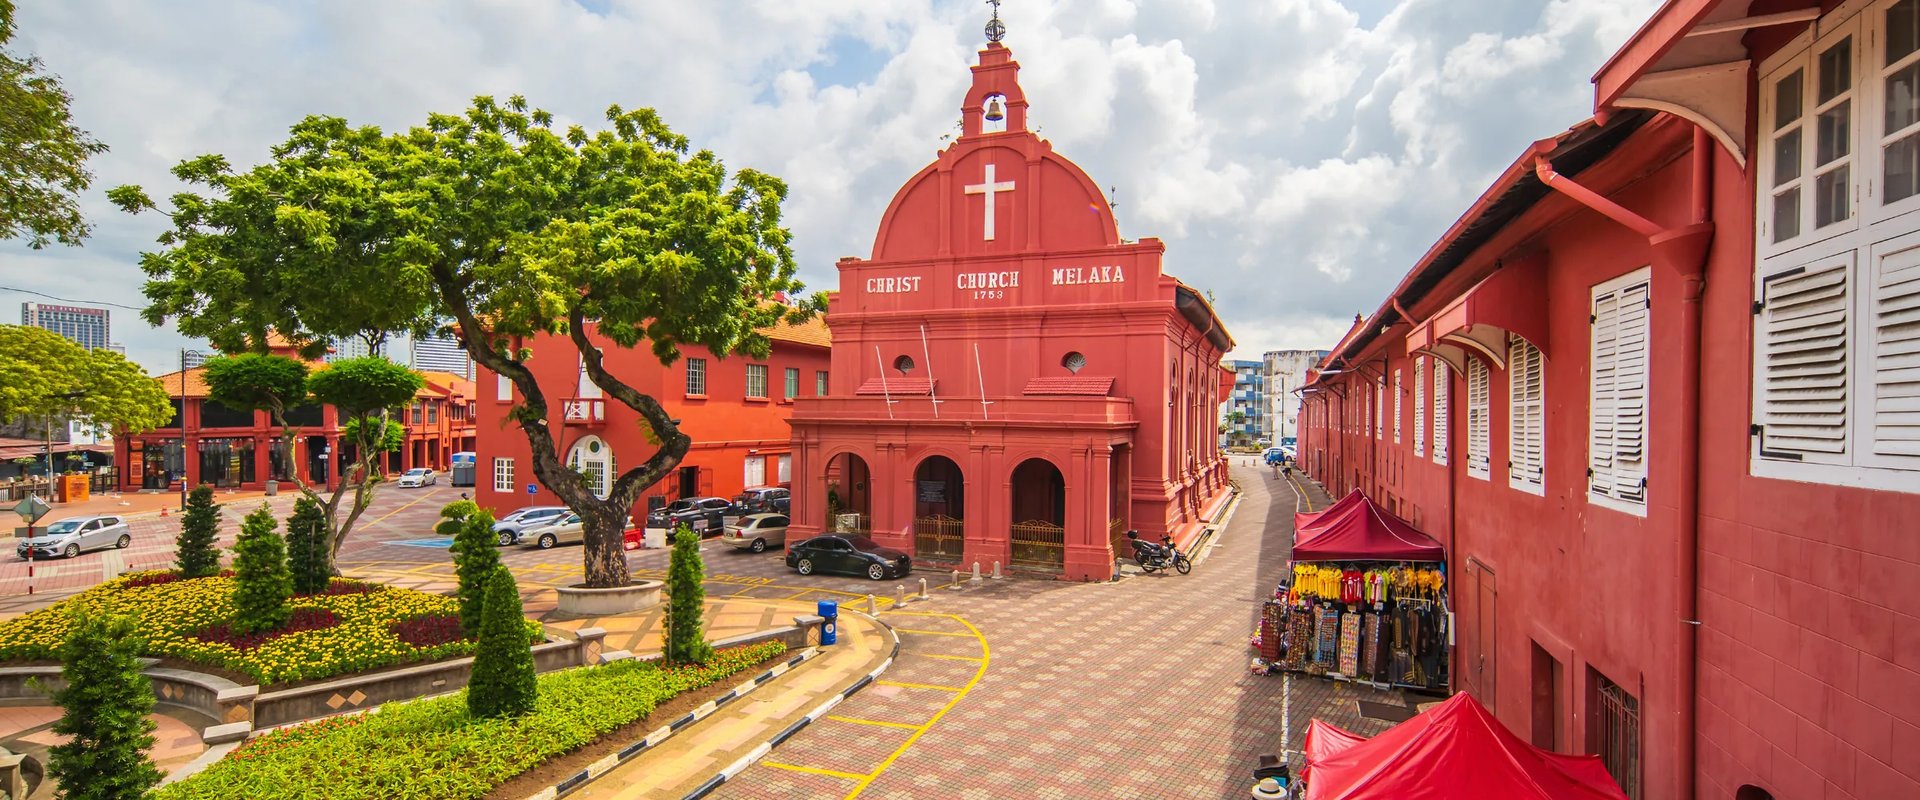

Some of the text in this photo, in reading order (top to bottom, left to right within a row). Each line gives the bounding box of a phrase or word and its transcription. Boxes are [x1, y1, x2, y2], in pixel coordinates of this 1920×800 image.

[867, 265, 1125, 293] CHRIST CHURCH MELAKA
[974, 290, 1003, 300] 1753
